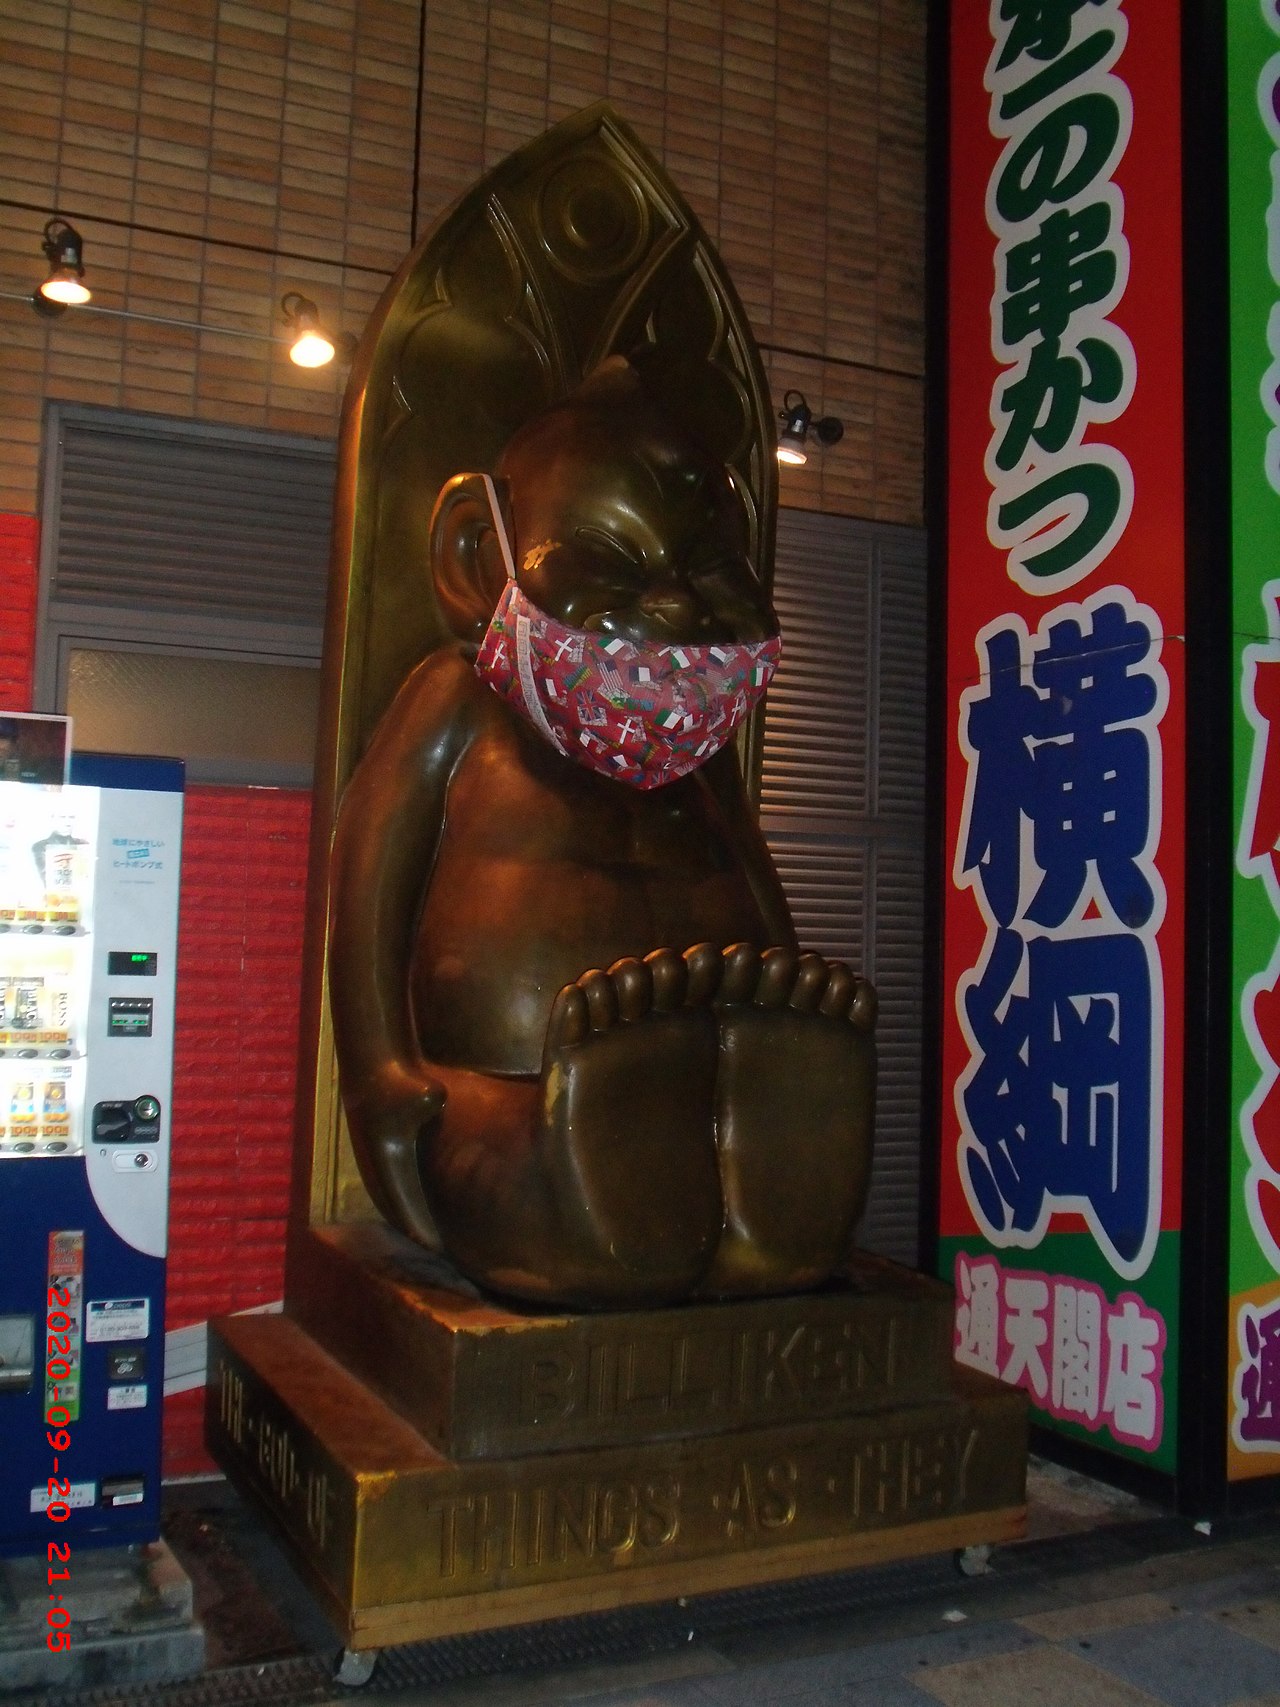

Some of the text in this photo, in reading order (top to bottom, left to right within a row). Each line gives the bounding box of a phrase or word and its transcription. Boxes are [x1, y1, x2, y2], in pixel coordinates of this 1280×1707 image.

[963, 602, 1158, 1263] 横綱
[527, 1318, 896, 1427] BILLIKEN
[955, 1261, 1157, 1441] 通天閣店
[428, 1474, 683, 1578] THINGS
